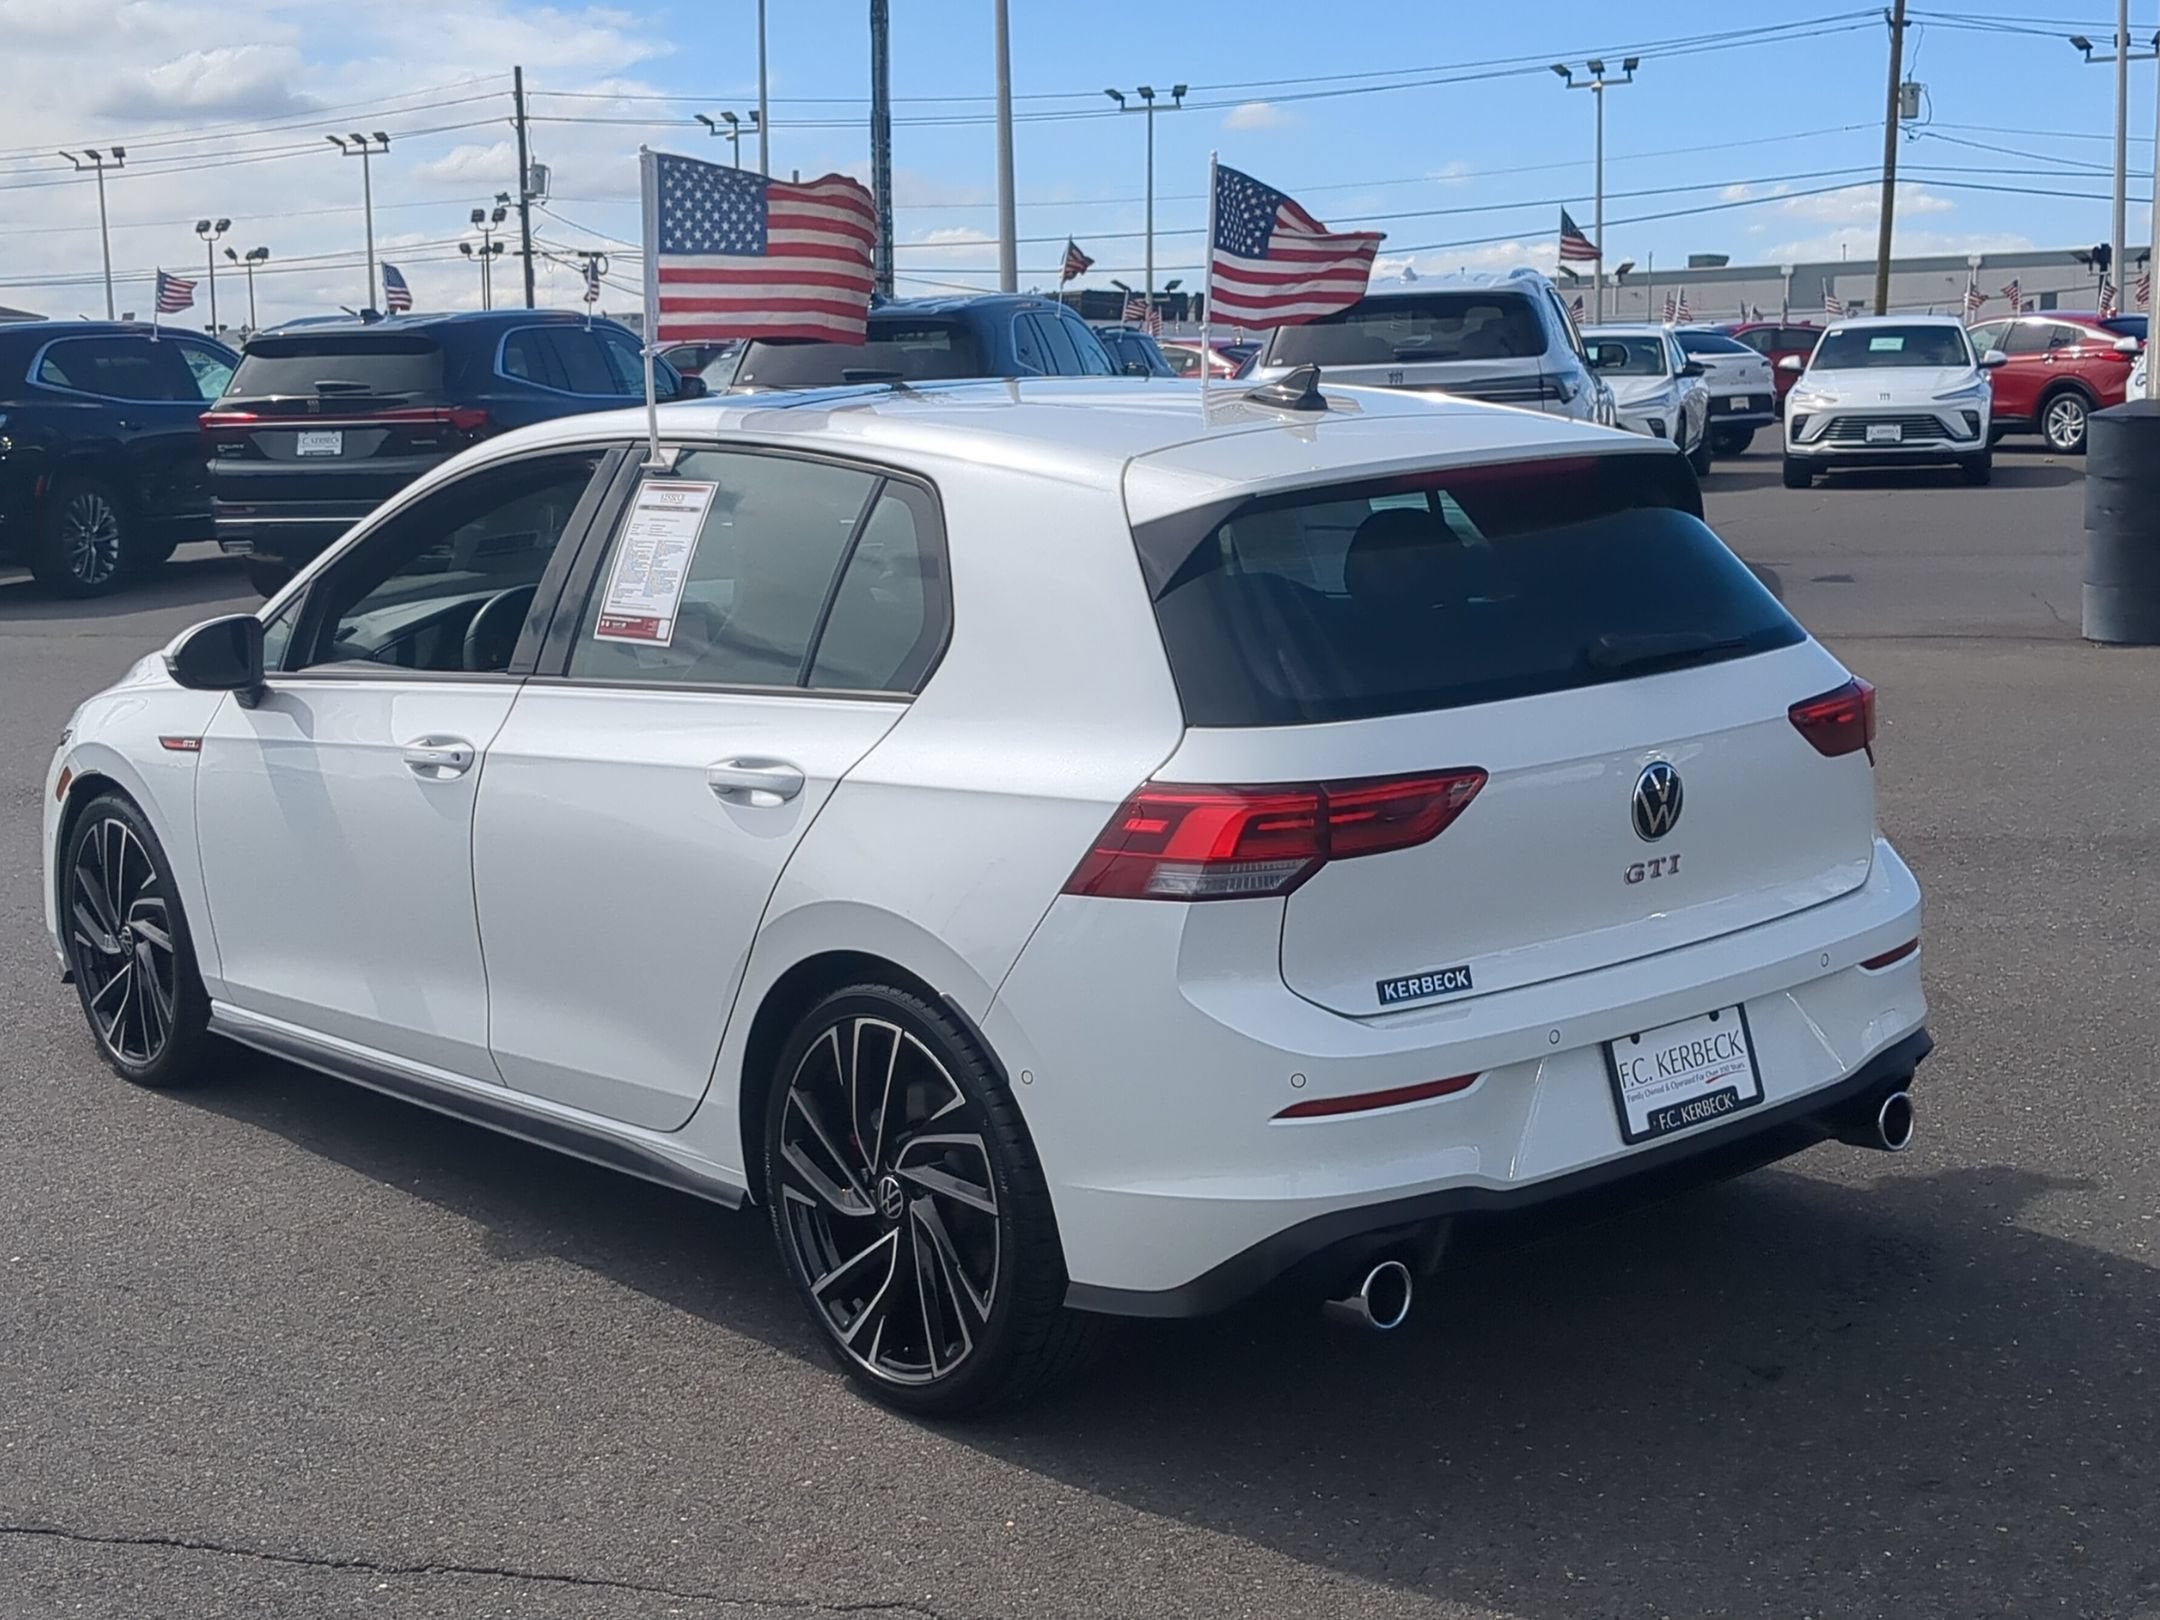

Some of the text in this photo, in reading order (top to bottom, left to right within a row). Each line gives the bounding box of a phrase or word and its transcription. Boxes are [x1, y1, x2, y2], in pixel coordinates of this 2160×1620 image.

[1624, 854, 1681, 885] GTI
[1383, 969, 1469, 1000] KERBECK
[1619, 1029, 1744, 1089] F.C. KERBECK
[1658, 1092, 1734, 1130] F.C. KERBECK
